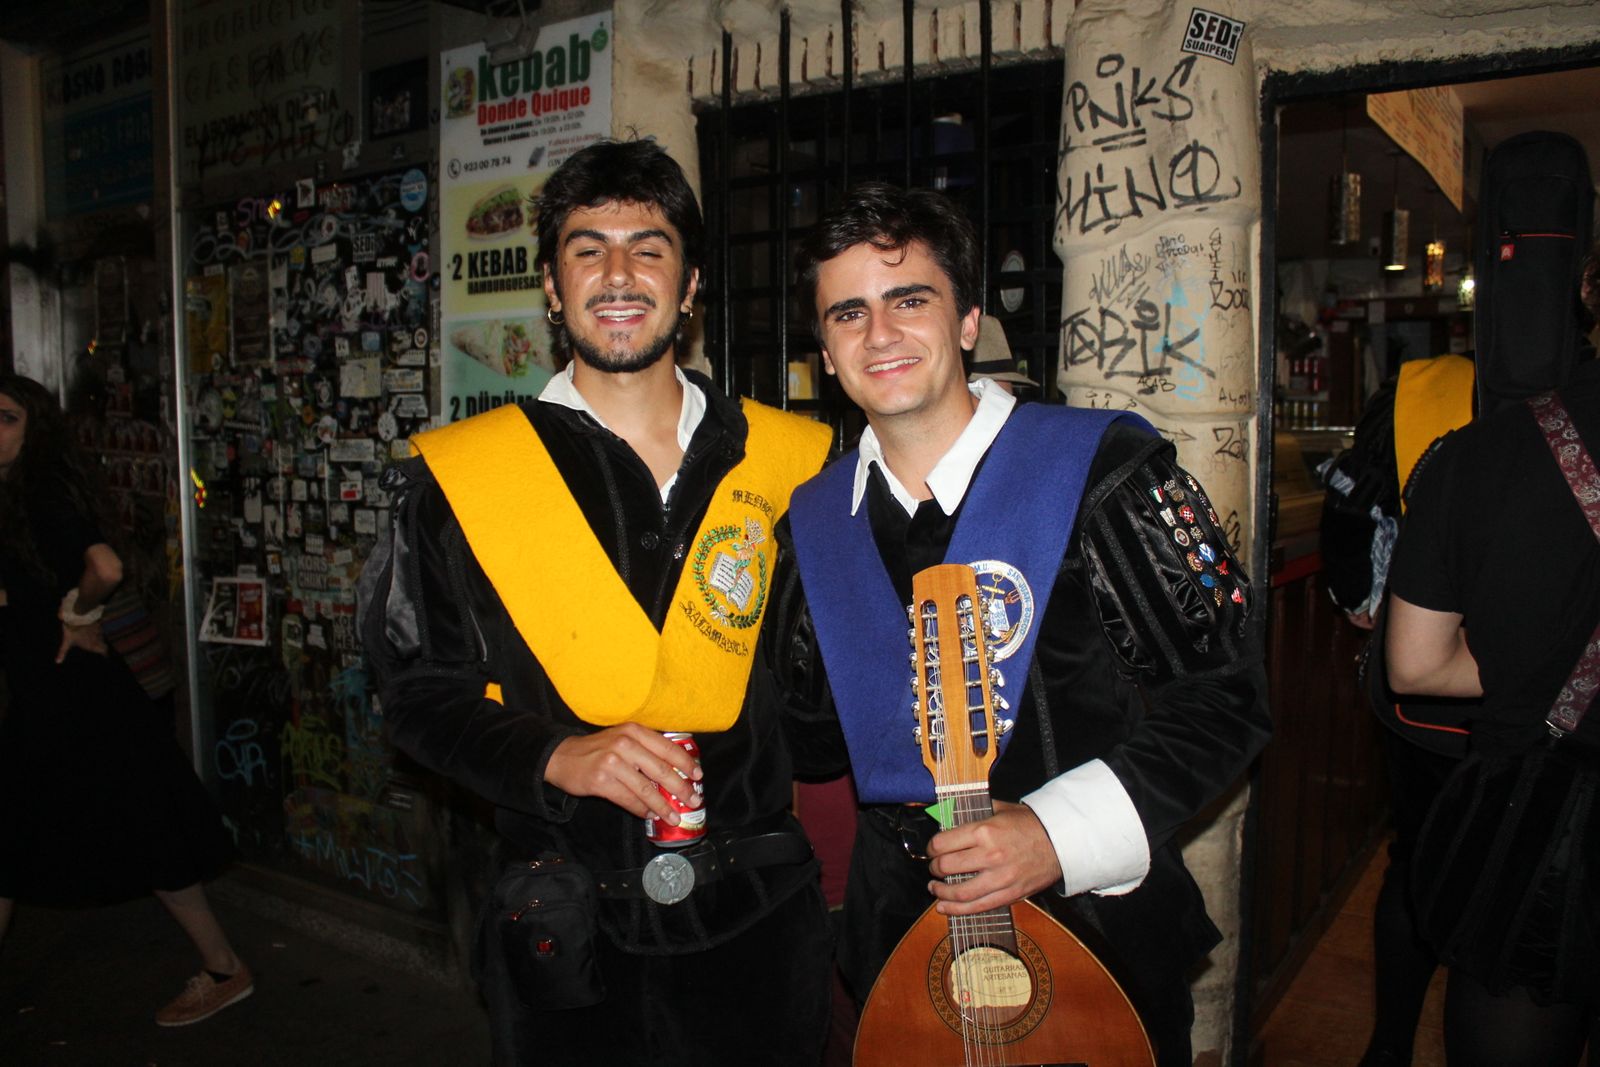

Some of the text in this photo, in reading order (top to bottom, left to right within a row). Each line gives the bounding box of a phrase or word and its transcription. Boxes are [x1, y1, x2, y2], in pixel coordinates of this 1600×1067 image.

[477, 86, 591, 125] Donde Quique
[479, 159, 490, 170] 00
[501, 156, 511, 166] 74
[452, 253, 463, 280] 2
[467, 246, 528, 279] KEBAB
[467, 275, 542, 295] HAMBURGUESAS
[450, 396, 460, 422] 2
[680, 600, 749, 657] SALAMANCA
[983, 972, 1027, 981] ARTESANAS
